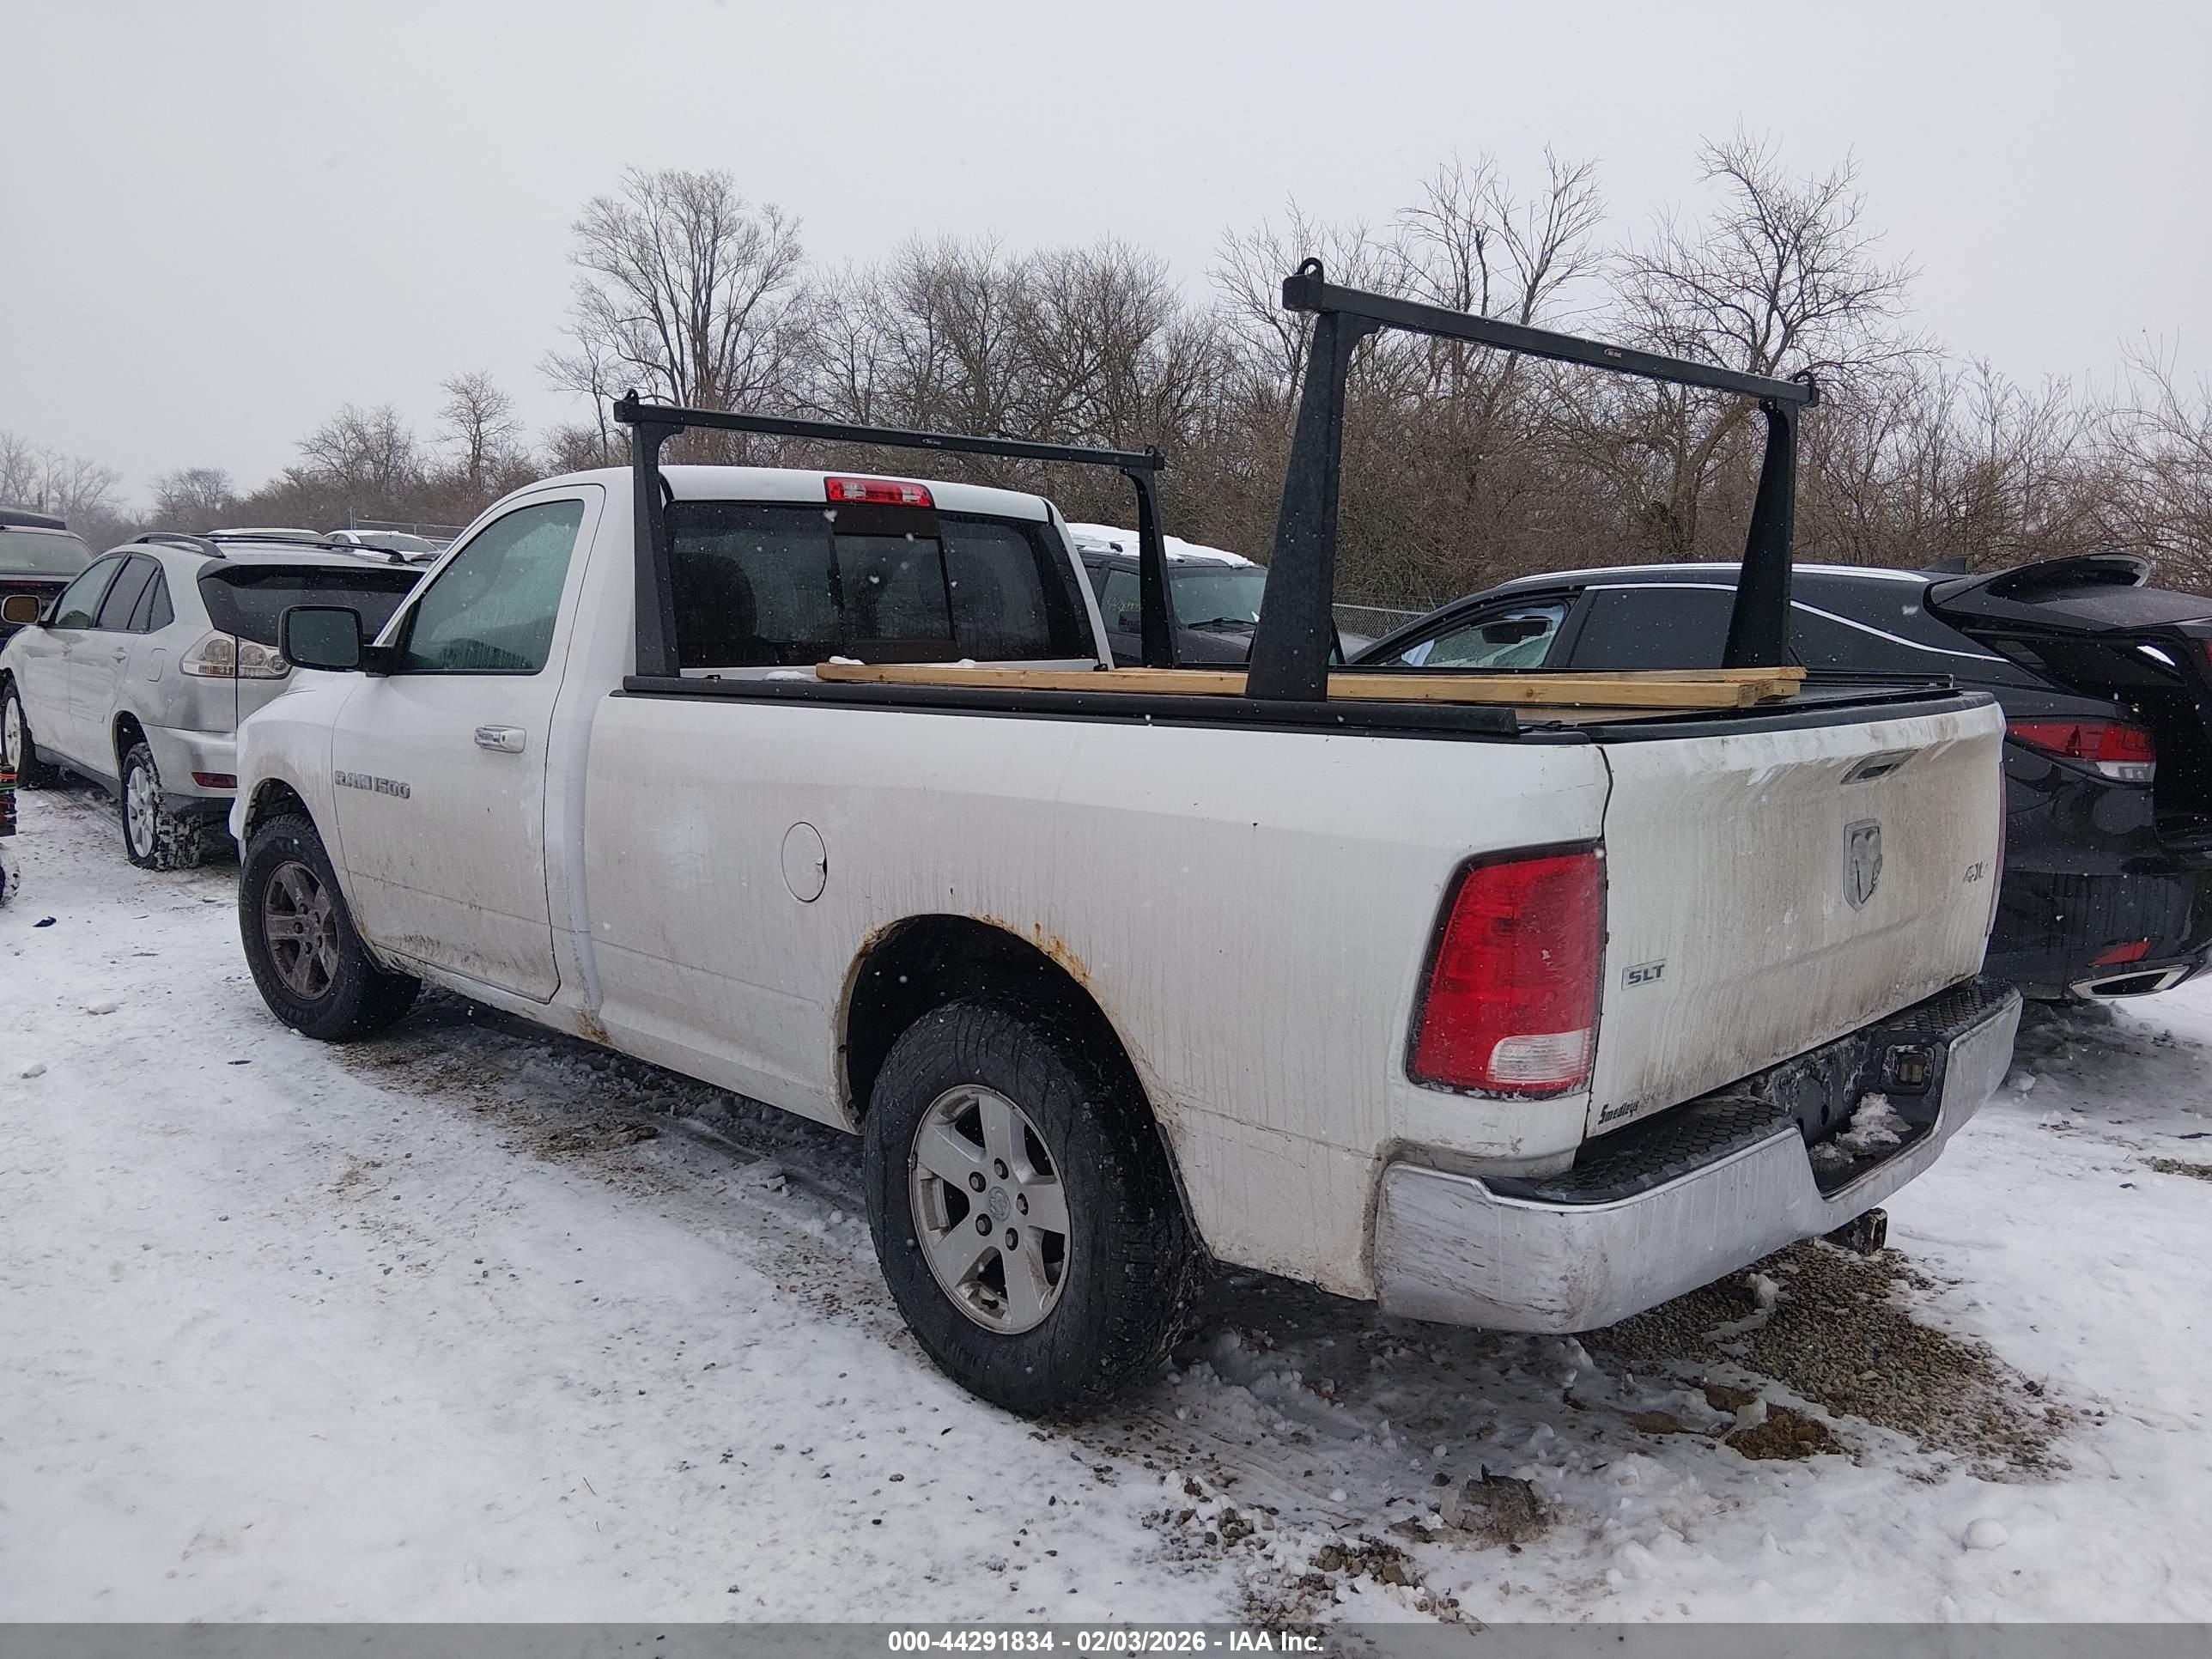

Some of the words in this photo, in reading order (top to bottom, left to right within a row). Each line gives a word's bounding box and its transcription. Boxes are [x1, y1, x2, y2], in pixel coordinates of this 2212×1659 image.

[335, 770, 372, 791] RAM
[374, 777, 410, 799] 1500
[1628, 963, 1665, 985] SLT
